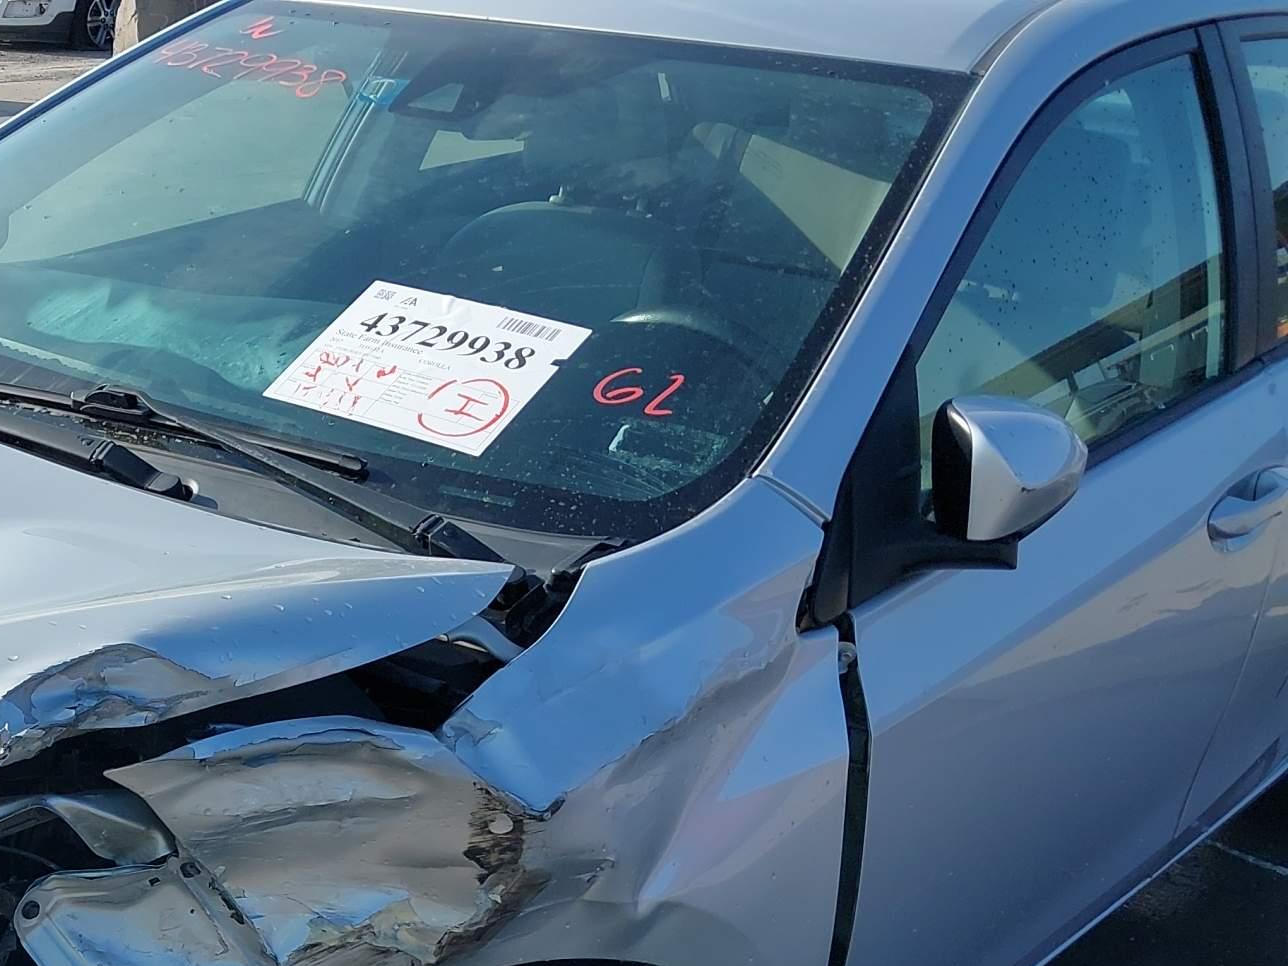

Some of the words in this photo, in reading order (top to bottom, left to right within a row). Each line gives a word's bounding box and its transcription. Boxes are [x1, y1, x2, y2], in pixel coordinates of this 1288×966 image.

[336, 328, 358, 339] State
[358, 331, 381, 345] Farm
[382, 337, 423, 355] Insurance
[359, 312, 536, 371] 43729938
